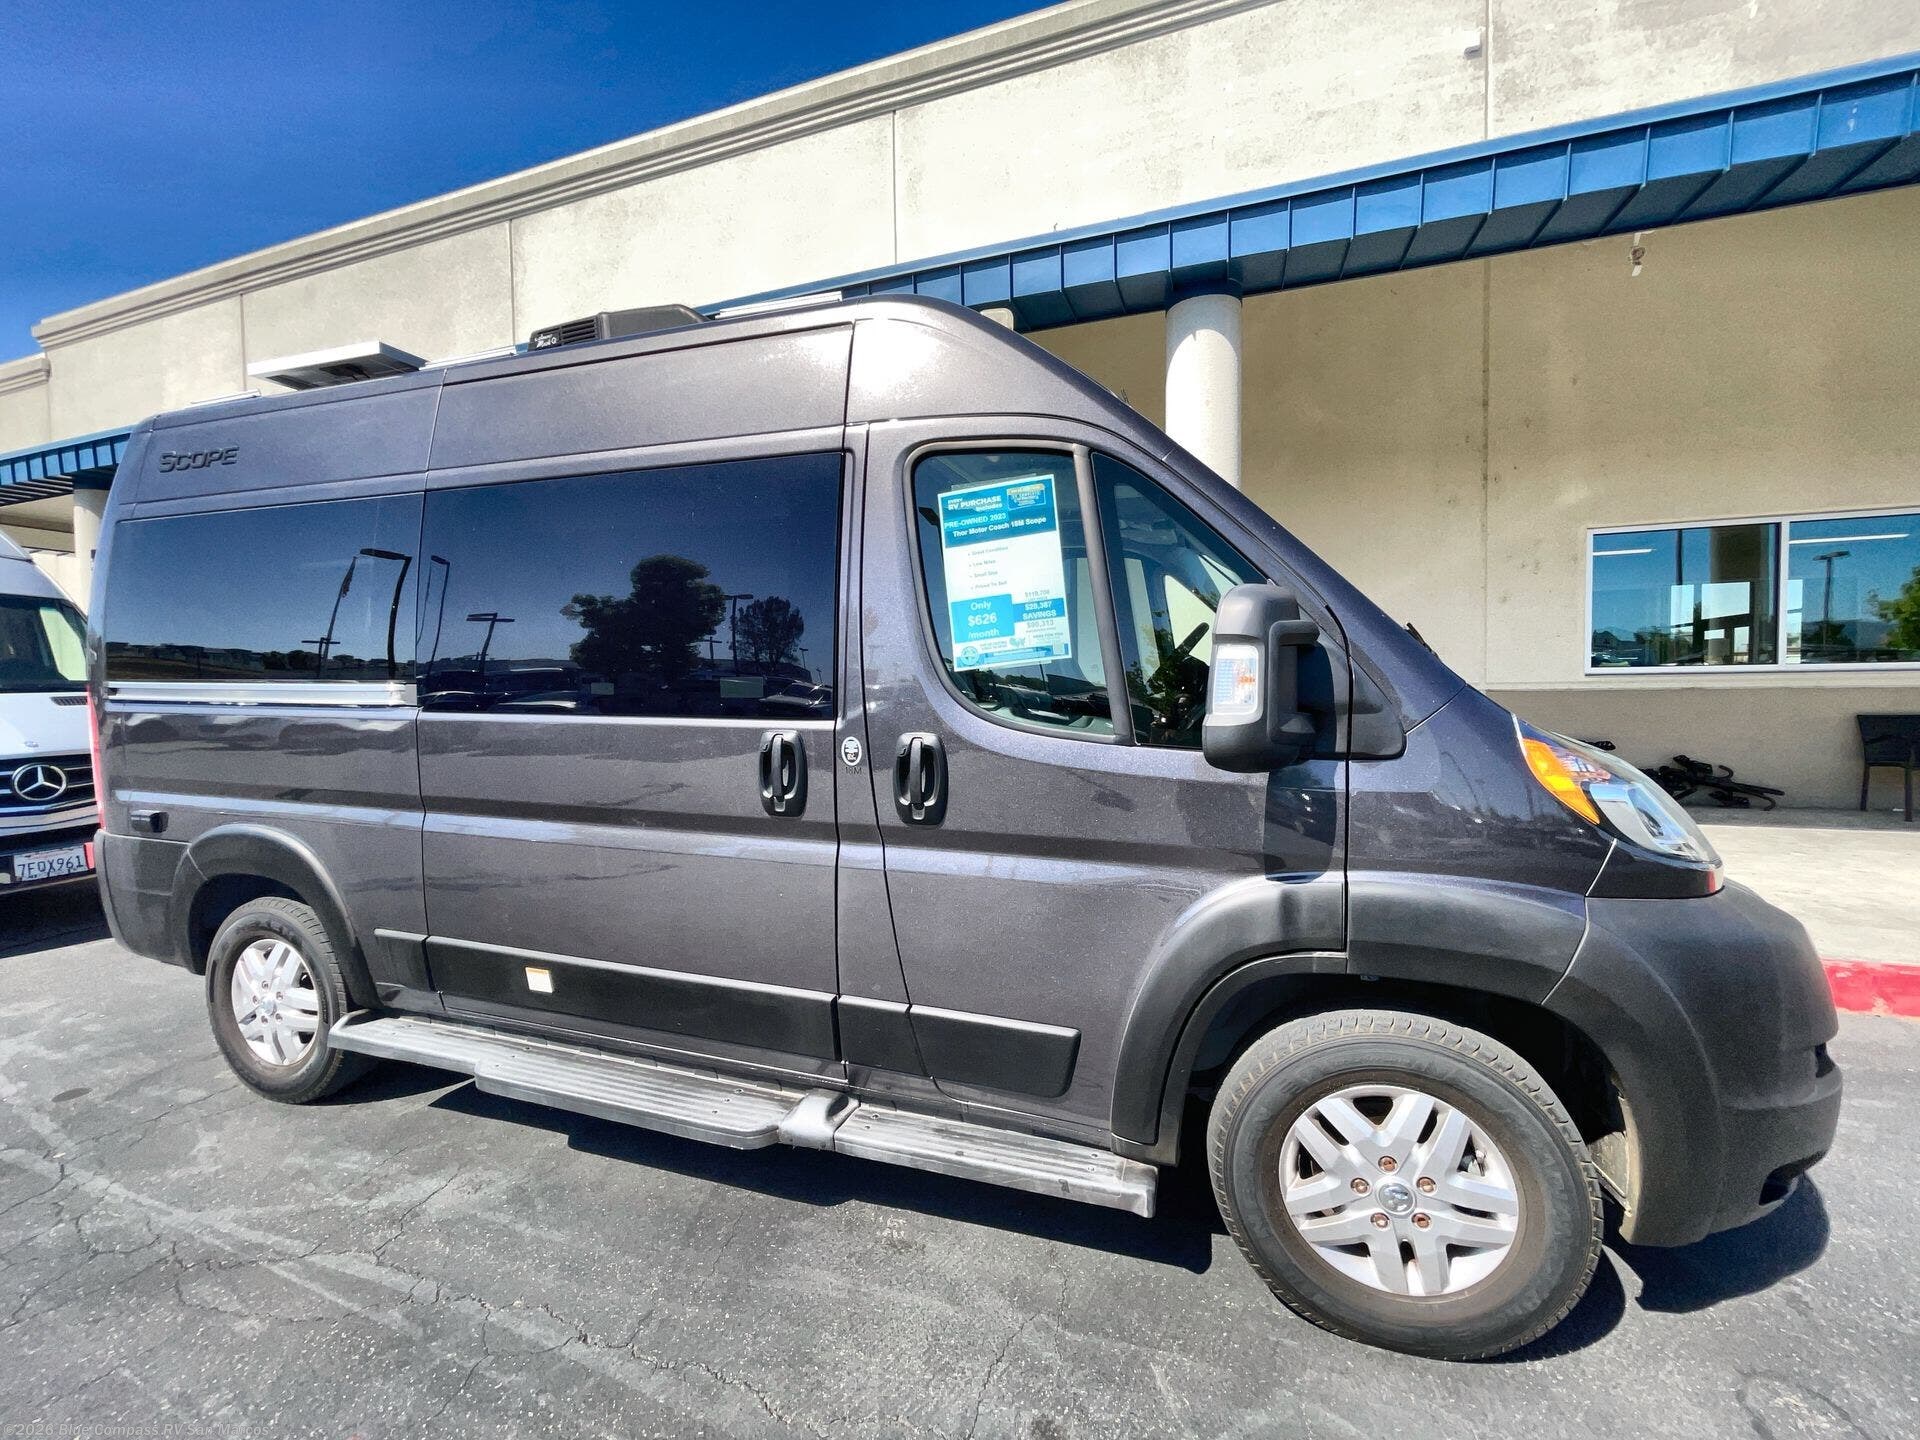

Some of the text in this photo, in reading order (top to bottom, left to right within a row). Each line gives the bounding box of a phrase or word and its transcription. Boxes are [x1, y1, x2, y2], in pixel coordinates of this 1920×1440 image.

[160, 446, 240, 473] SCOPE
[948, 503, 959, 511] RV
[960, 496, 1002, 508] PURCHASE
[944, 513, 1007, 529] PRE-OWNED 2023
[953, 530, 969, 538] Thor
[968, 526, 987, 535] Motor
[988, 522, 1010, 532] Coach
[1025, 516, 1047, 526] Scope
[970, 600, 992, 611] Only
[967, 612, 998, 627] $626
[1022, 610, 1057, 620] SAVINGS
[968, 628, 1000, 640] /month
